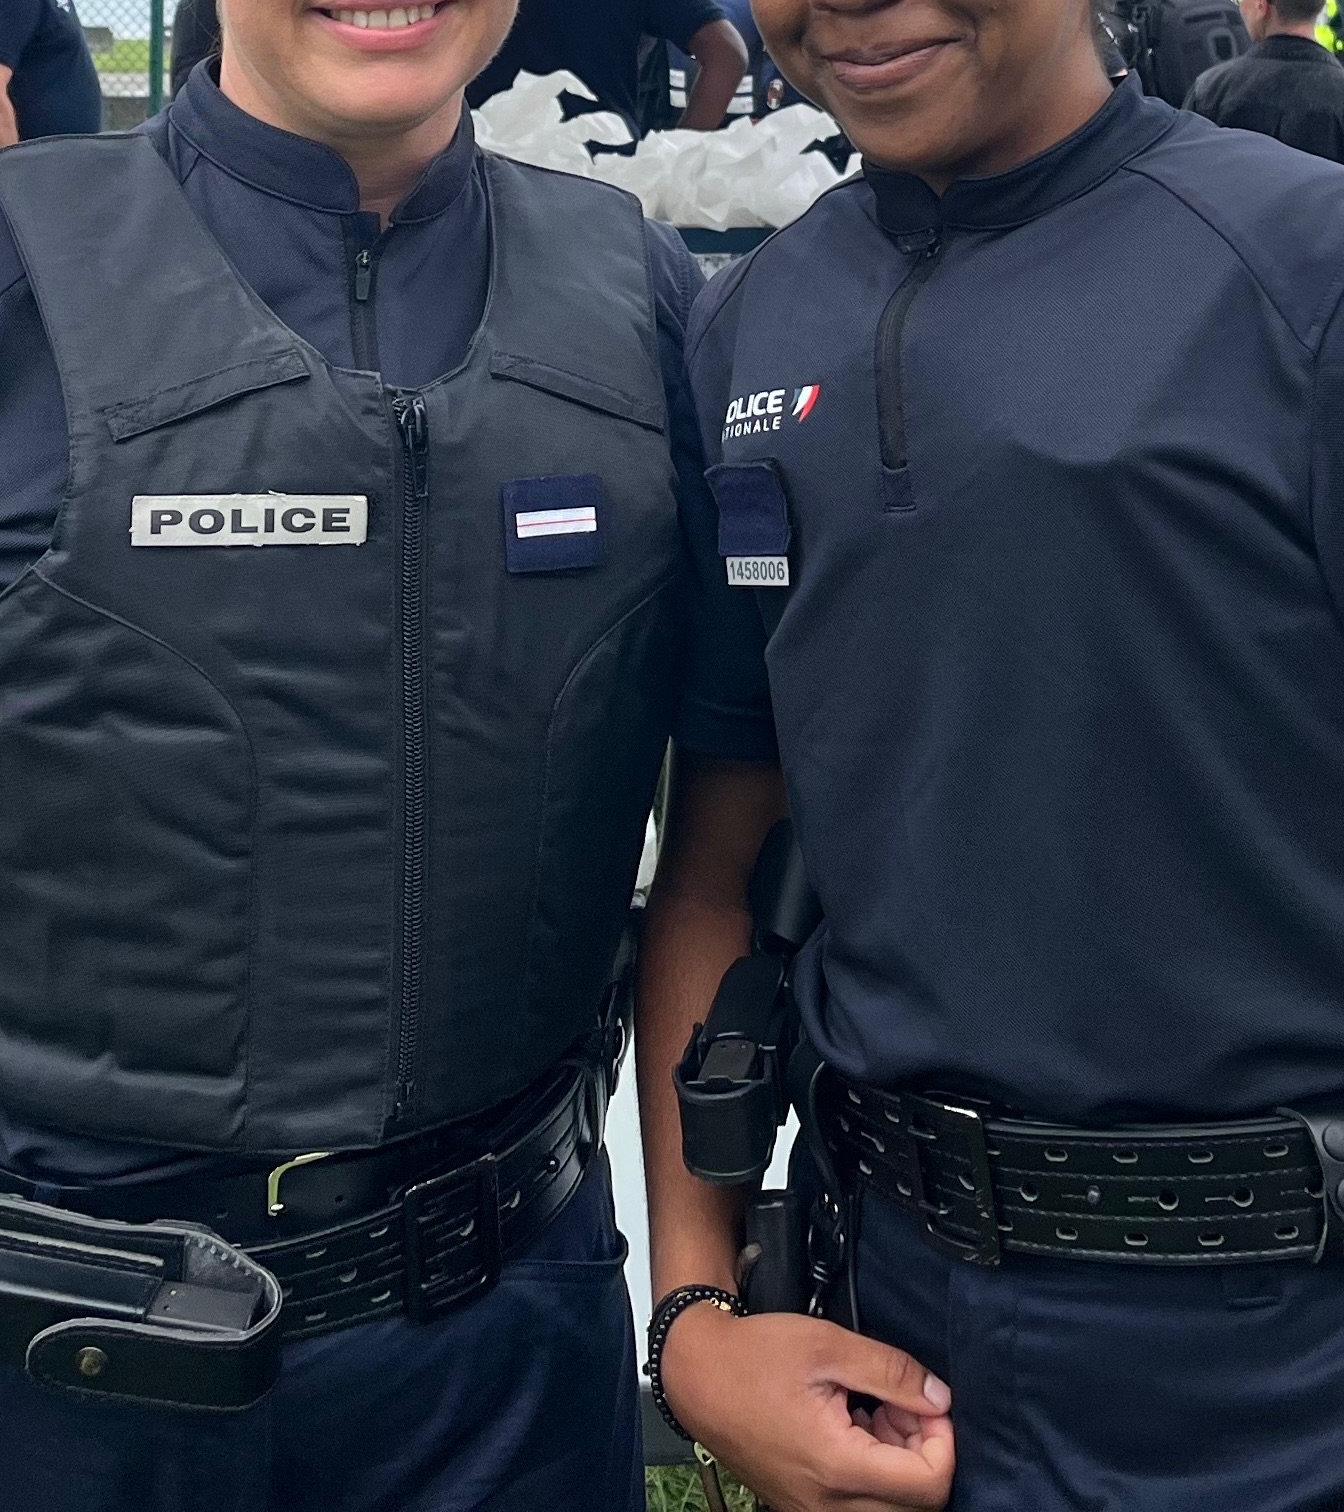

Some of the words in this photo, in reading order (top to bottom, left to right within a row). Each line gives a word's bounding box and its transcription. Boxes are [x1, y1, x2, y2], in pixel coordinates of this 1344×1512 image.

[726, 388, 785, 424] OLICE
[150, 507, 351, 535] POLICE
[729, 560, 785, 581] 1458006
